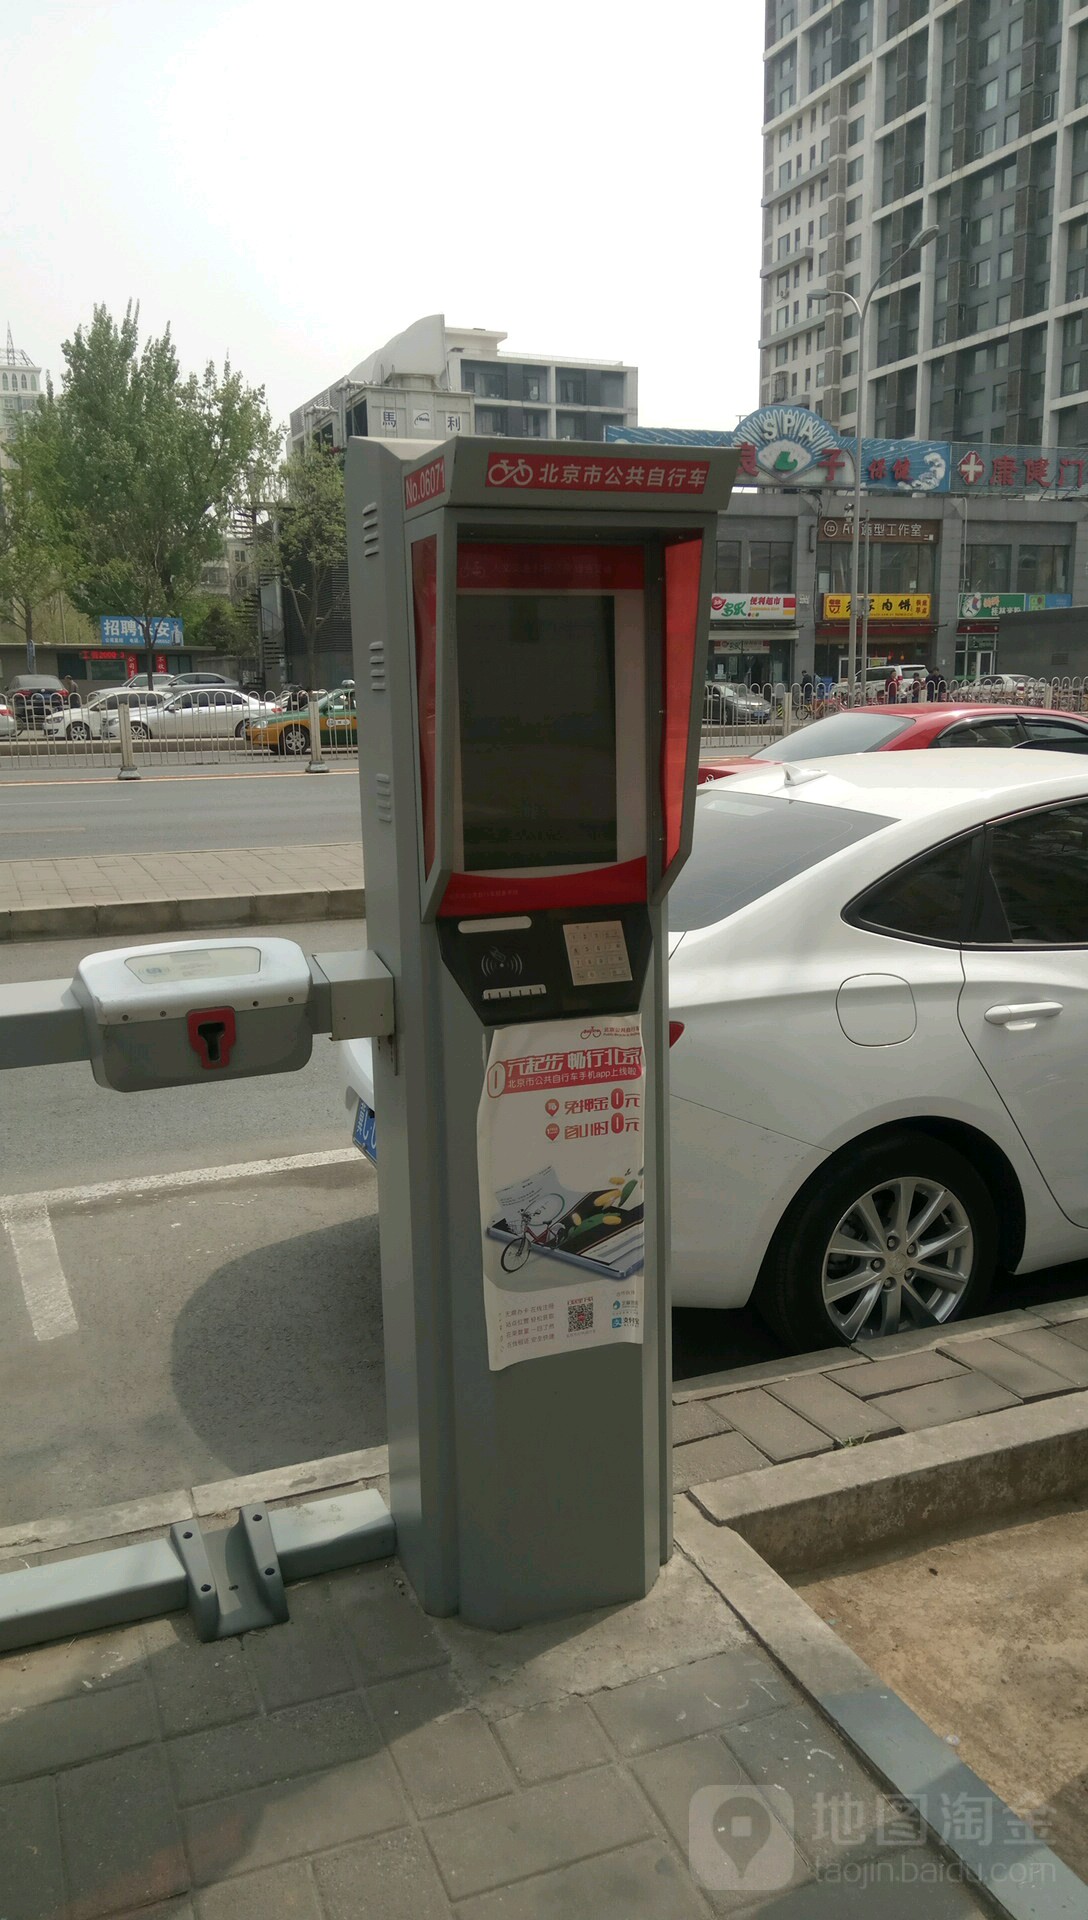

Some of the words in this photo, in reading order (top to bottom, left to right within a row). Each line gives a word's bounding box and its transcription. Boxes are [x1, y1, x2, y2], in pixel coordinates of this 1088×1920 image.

[382, 409, 397, 428] 馬
[447, 416, 461, 432] 利
[762, 413, 814, 442] SPA
[405, 461, 445, 505] No.06071
[538, 462, 708, 488] 北京市公共自行车
[567, 1047, 642, 1070] 畅行北京
[564, 1087, 641, 1115] 免押金0元
[564, 1112, 640, 1140] 首小时0元
